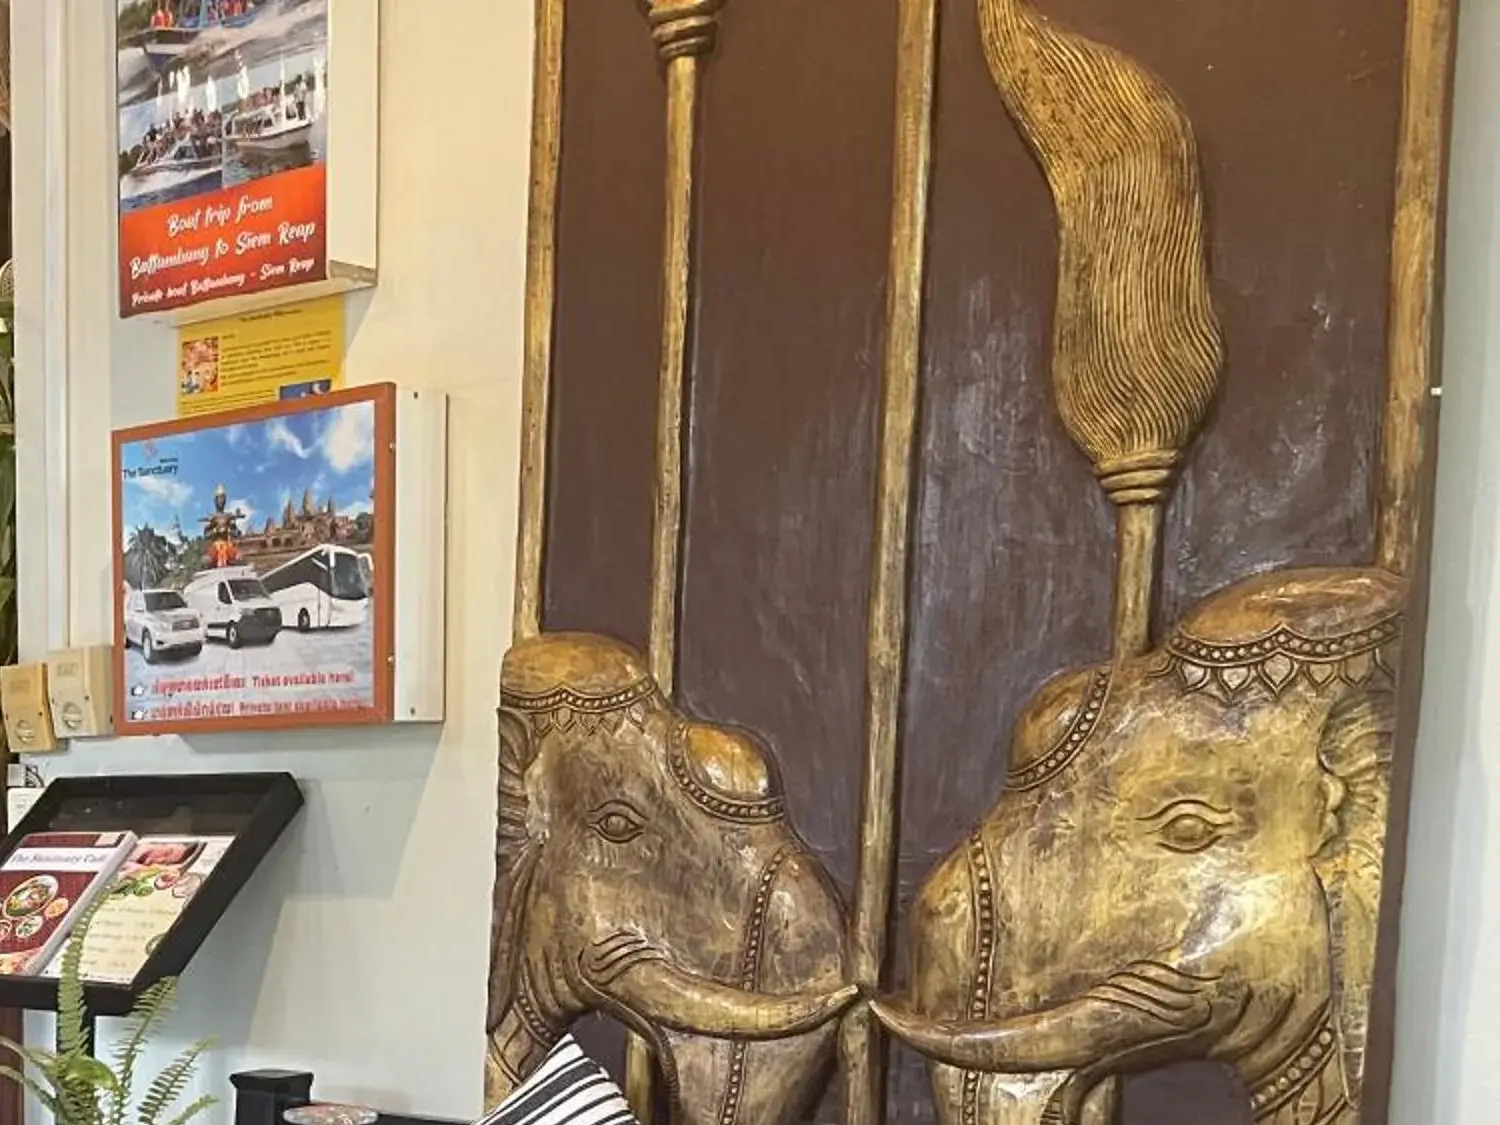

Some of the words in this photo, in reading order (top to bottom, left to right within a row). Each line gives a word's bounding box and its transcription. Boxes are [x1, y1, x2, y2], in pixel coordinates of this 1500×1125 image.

[167, 209, 200, 237] Boat
[205, 203, 231, 227] trip
[235, 194, 273, 224] from
[129, 245, 209, 280] Battambang
[214, 238, 229, 257] to
[235, 230, 272, 256] Siem
[277, 221, 316, 246] Reap
[259, 263, 286, 281] Siem
[288, 257, 316, 276] Reap
